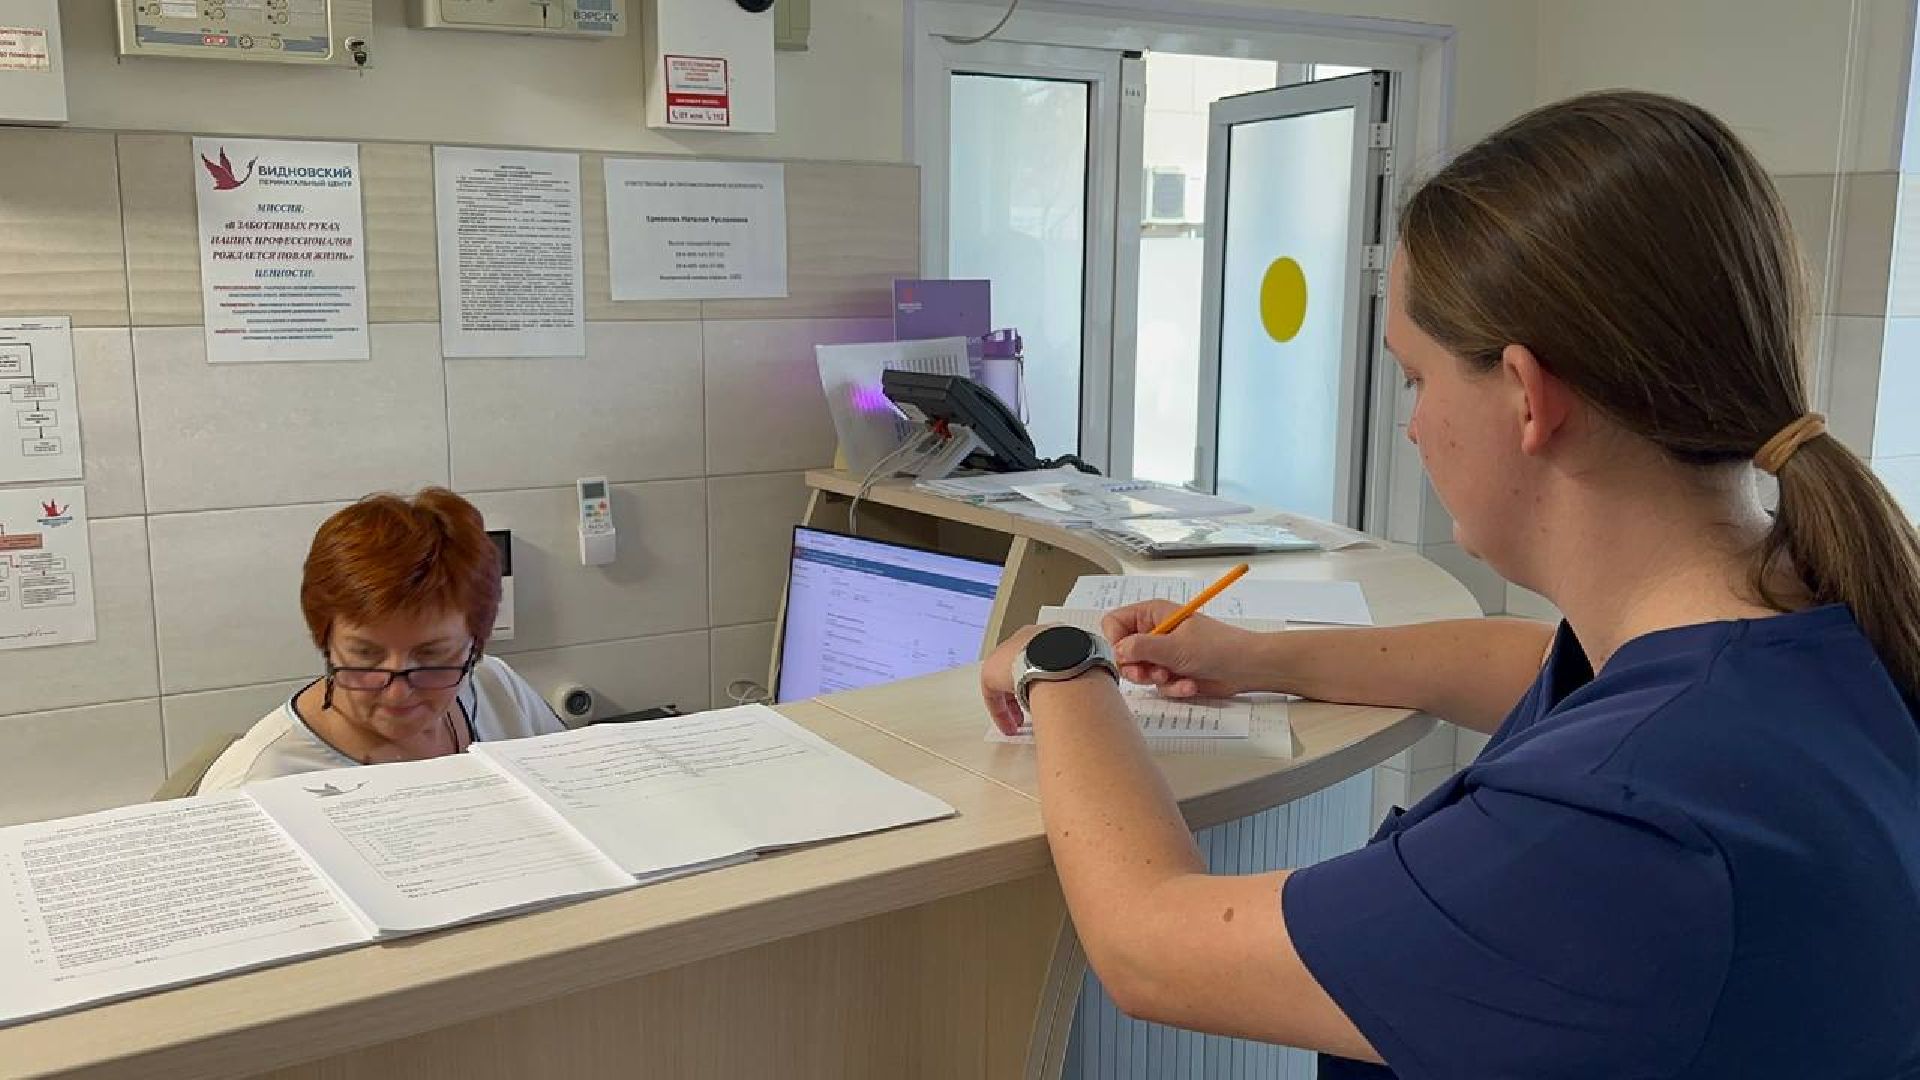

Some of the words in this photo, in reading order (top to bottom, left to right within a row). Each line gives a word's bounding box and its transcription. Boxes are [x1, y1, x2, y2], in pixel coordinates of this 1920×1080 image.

[258, 165, 352, 179] ВИДНОВСКИЙ
[258, 179, 326, 187] ПЕРИНАТАЛЬНЫЙ
[327, 180, 353, 188] ЦЕНТР
[257, 203, 304, 214] МИССИЯ:
[237, 221, 306, 230] ЗАБОТЛИВЫХ
[308, 222, 341, 231] РУКАХ
[211, 236, 251, 245] НАШИХ
[254, 236, 353, 246] ПРОФЕССИОНАЛОВ
[213, 251, 275, 260] РОЖДАЕТСЯ
[276, 251, 312, 260] НОВАЯ
[255, 269, 315, 278] ЦЕННОСТИ:
